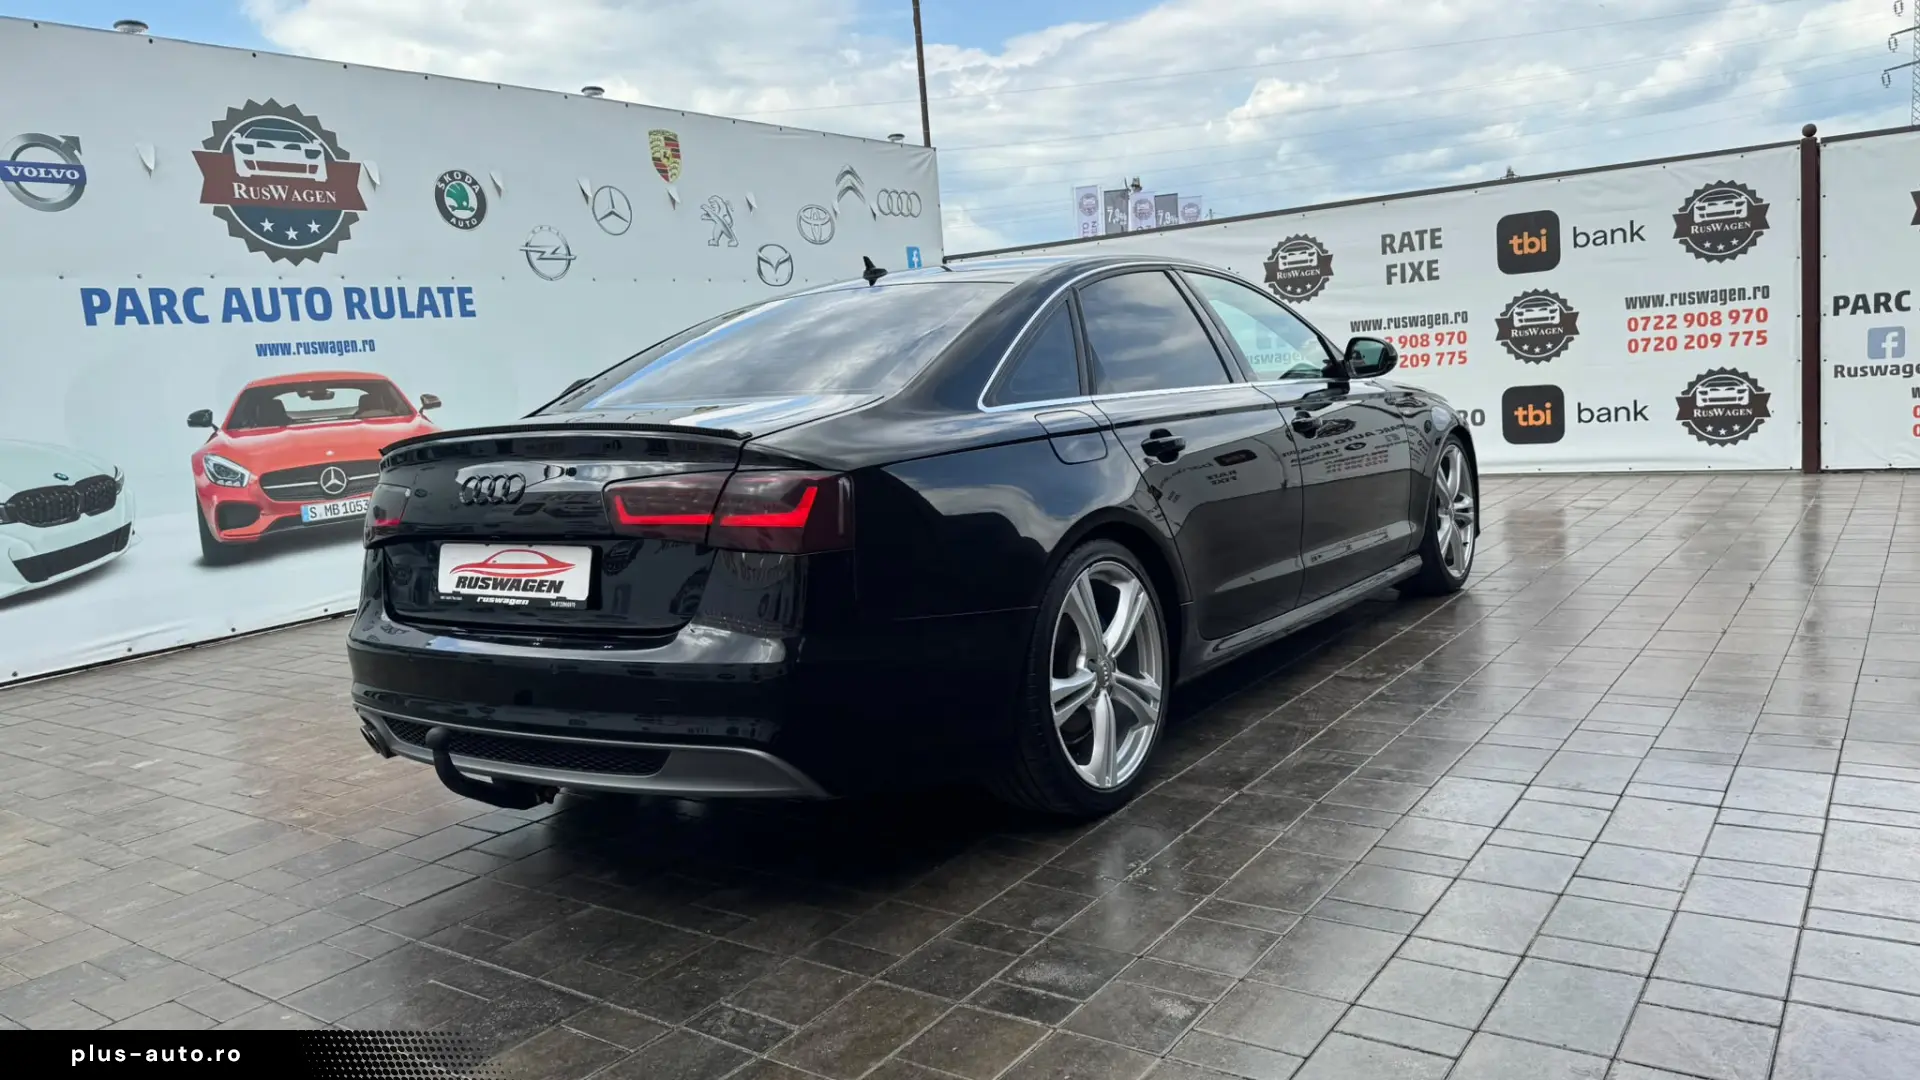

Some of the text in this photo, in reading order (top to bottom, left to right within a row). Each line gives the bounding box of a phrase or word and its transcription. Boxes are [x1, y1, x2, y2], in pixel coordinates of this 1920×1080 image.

[4, 166, 80, 180] VOLVO
[450, 217, 478, 228] AUTO
[1380, 227, 1443, 256] RATE
[1508, 219, 1647, 255] tbi bank
[1385, 259, 1441, 286] FIXE
[80, 286, 477, 326] PARC AUTO RULATE
[1624, 285, 1770, 311] www.ruswagen.ro
[1833, 290, 1911, 316] PARC
[1350, 310, 1469, 333] www.ruswagen.ro
[1627, 307, 1769, 332] 0722 908 970
[255, 338, 376, 358] www.ruswagen.ro
[1398, 332, 1430, 350] 908
[1434, 330, 1468, 347] 970
[1627, 329, 1769, 354] 0720 209 775
[1399, 350, 1468, 369] 209 775
[1514, 399, 1650, 427] tbi bank
[309, 507, 317, 518] S
[324, 503, 340, 517] MB
[455, 576, 564, 593] RUSWAGEN
[476, 596, 530, 606] ruswagen
